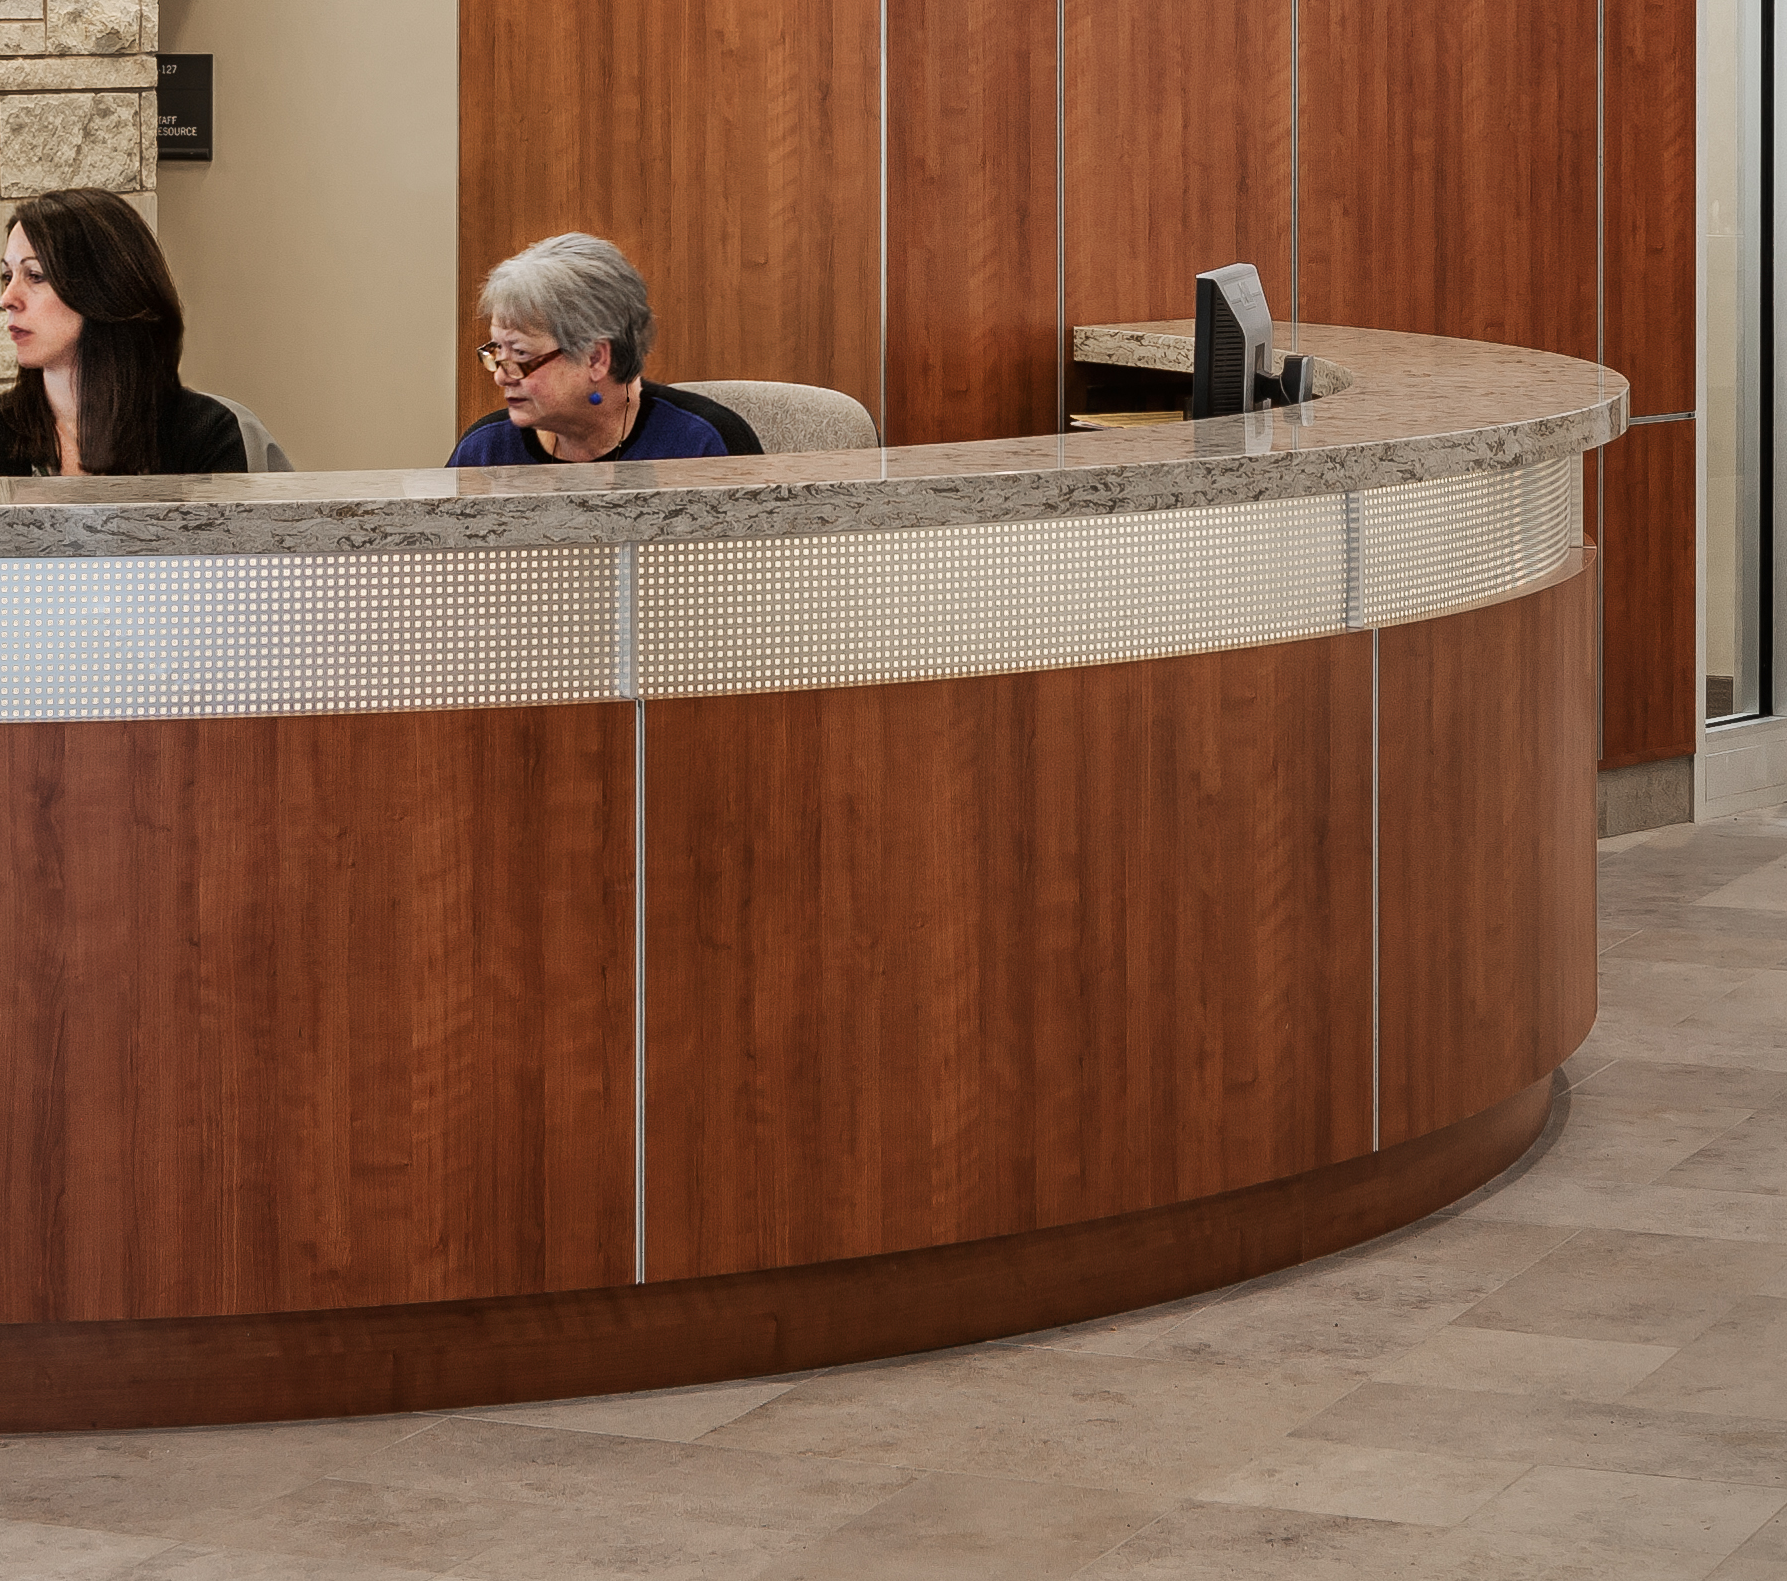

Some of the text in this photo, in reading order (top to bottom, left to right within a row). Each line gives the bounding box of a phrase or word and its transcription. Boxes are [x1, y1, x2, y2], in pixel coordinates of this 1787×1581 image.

[159, 64, 178, 75] -127
[158, 115, 178, 125] TAFF
[158, 126, 198, 137] ESOURCE
